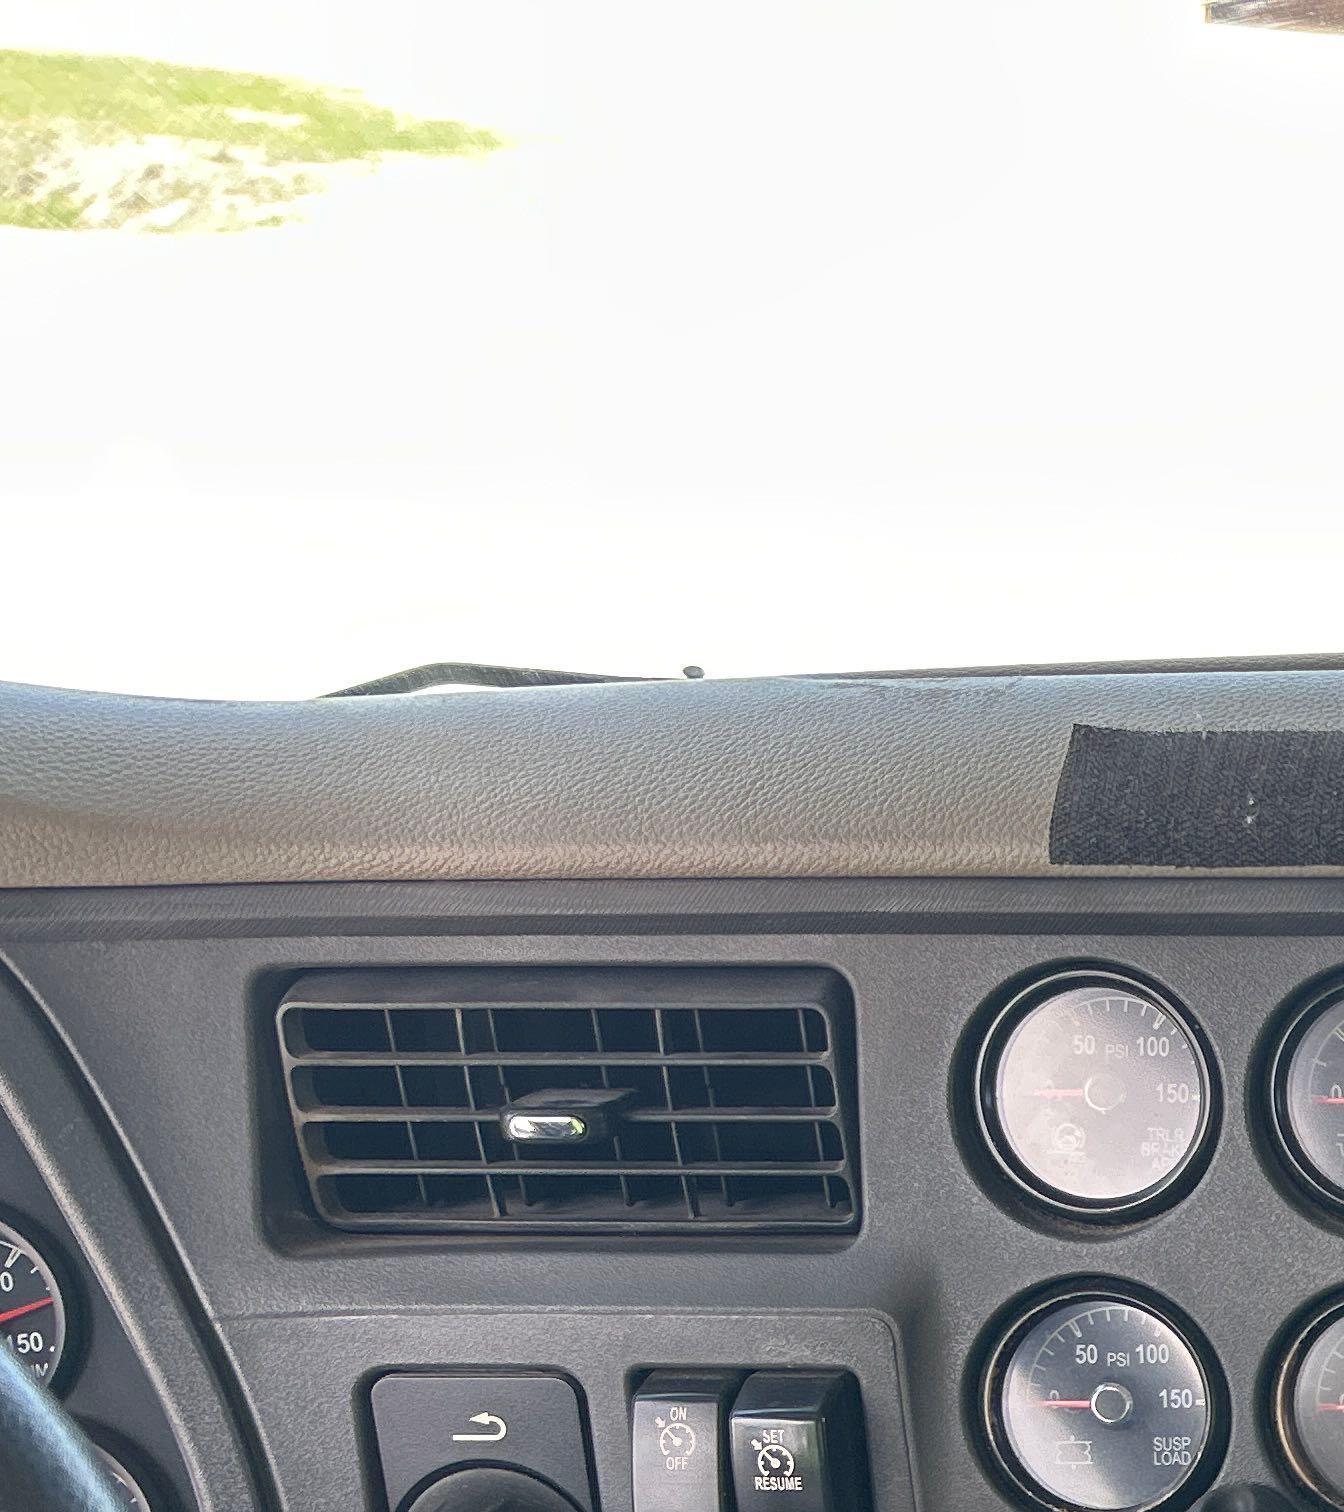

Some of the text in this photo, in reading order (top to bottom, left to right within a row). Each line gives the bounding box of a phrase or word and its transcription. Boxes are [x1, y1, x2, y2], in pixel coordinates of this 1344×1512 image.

[1073, 1035, 1170, 1058] 50 PSI 100
[1156, 1083, 1189, 1104] 150
[1075, 1344, 1170, 1367] 50 PSI 100
[1159, 1388, 1193, 1409] 150
[670, 1407, 687, 1422] ON
[762, 1429, 784, 1444] SET
[1152, 1436, 1191, 1451] SUSP
[666, 1456, 688, 1471] OFF
[1153, 1452, 1192, 1466] LOAD
[755, 1476, 803, 1491] RESUME
